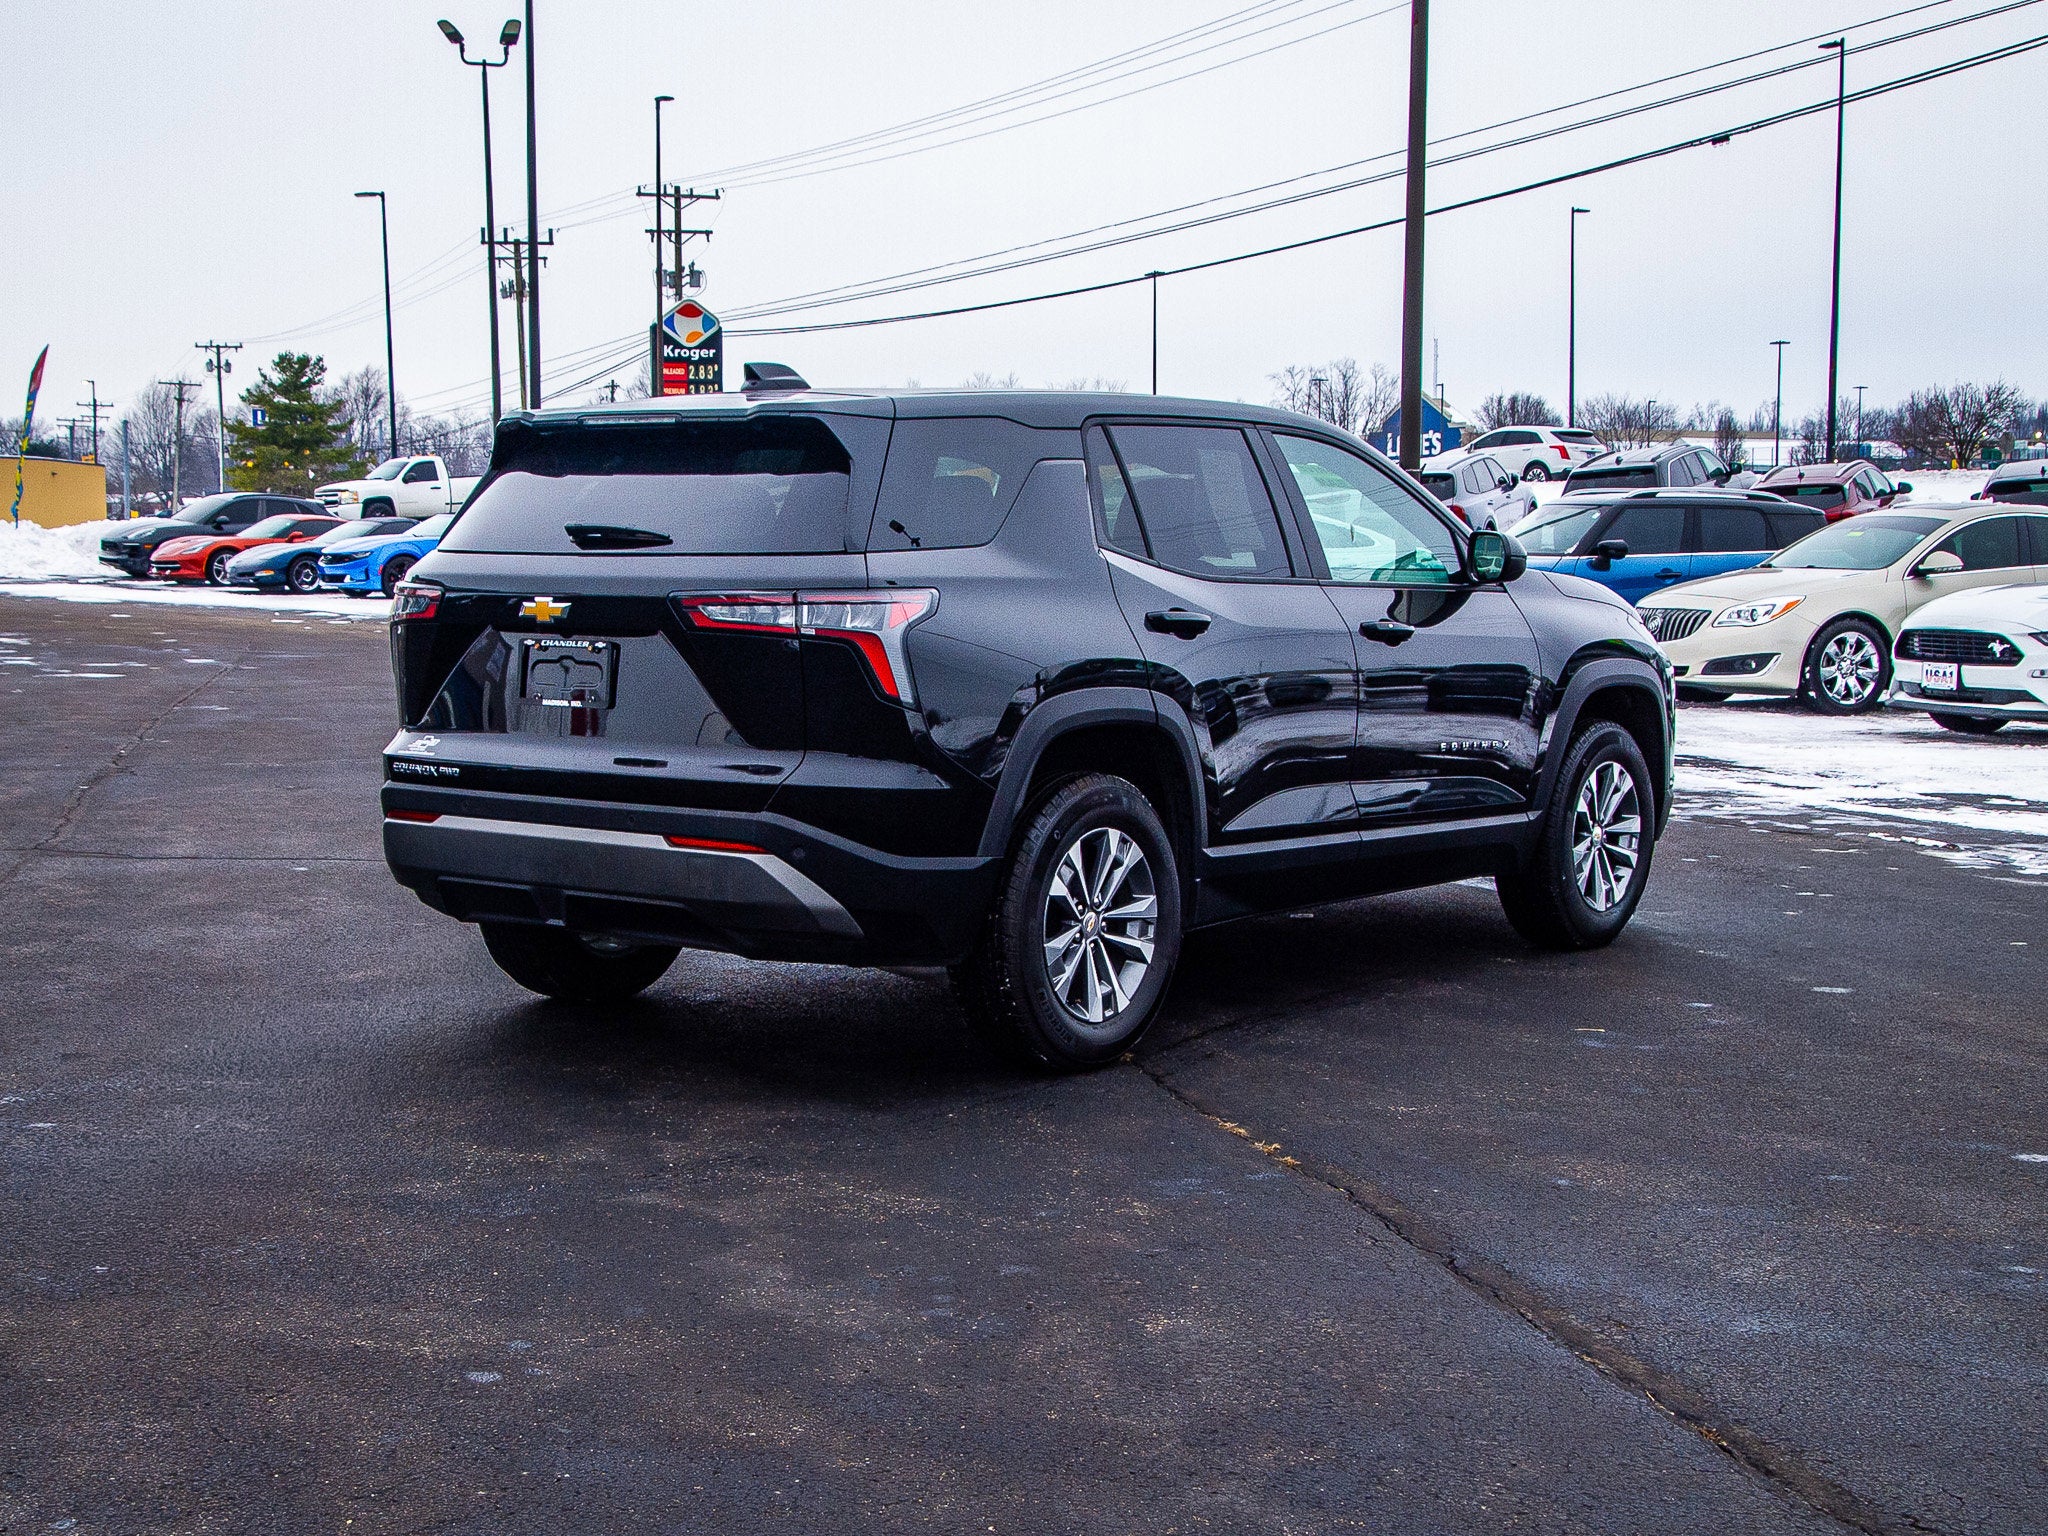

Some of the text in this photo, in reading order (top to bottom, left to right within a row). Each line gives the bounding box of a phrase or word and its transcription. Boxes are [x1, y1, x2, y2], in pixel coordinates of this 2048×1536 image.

[663, 344, 717, 360] Kroger
[1386, 429, 1442, 457] LE'S
[540, 639, 590, 648] CHANDLER
[1925, 669, 1954, 684] USA1
[1440, 739, 1510, 752] EQUINOX
[392, 761, 438, 777] EQUINOX
